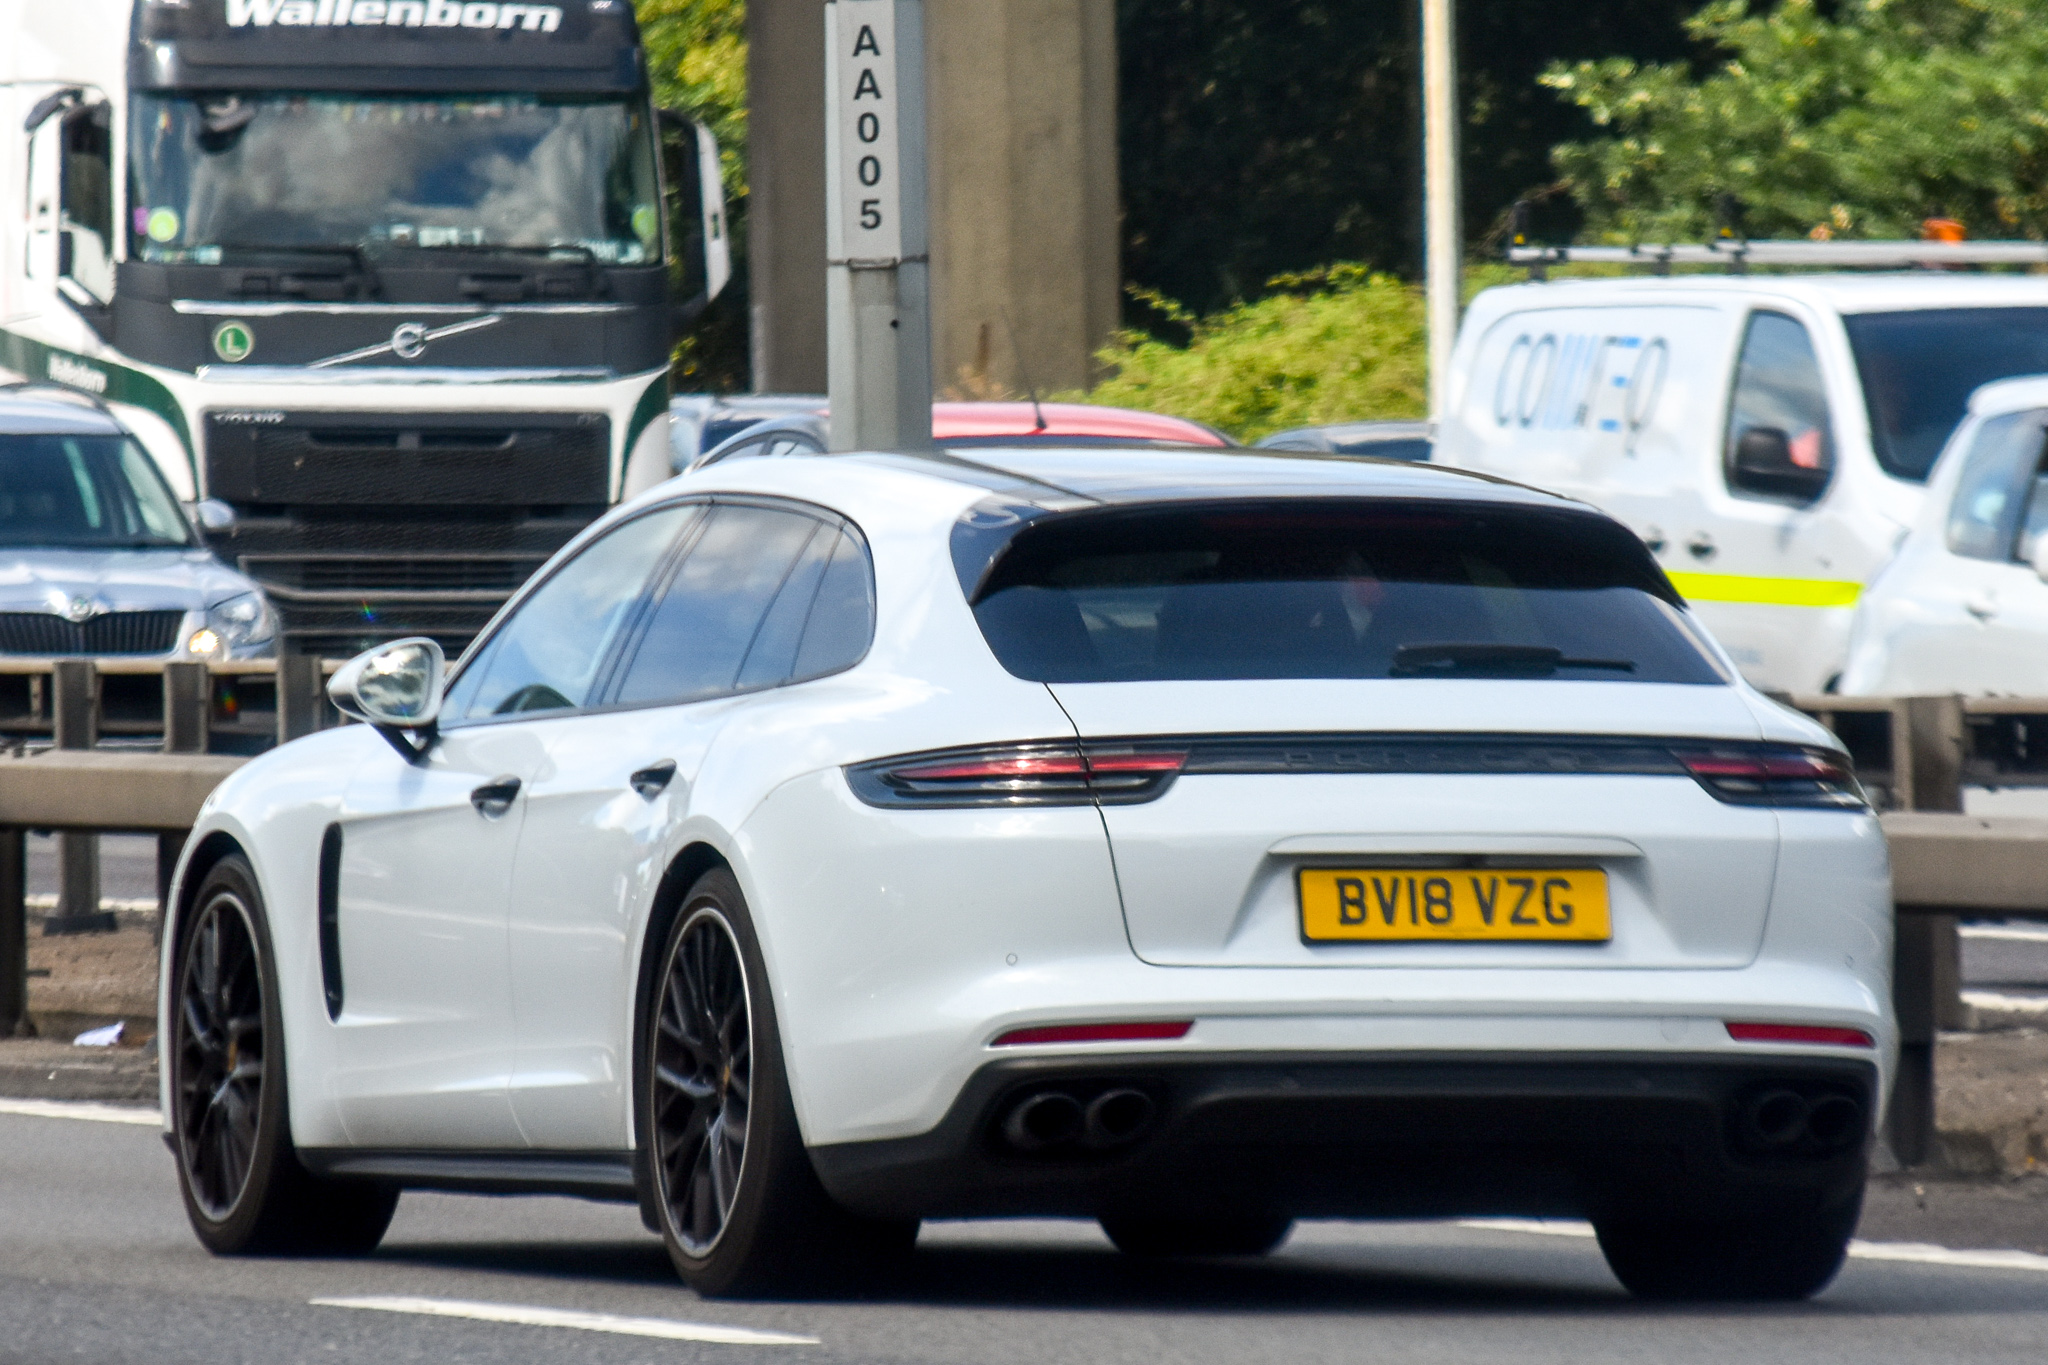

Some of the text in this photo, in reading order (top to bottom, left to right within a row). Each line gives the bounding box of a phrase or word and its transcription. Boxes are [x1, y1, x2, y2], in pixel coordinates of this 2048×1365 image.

[225, 0, 563, 32] Wallenborn
[852, 24, 882, 230] AA005
[226, 331, 245, 355] L
[1335, 877, 1575, 926] BV18 VZG
